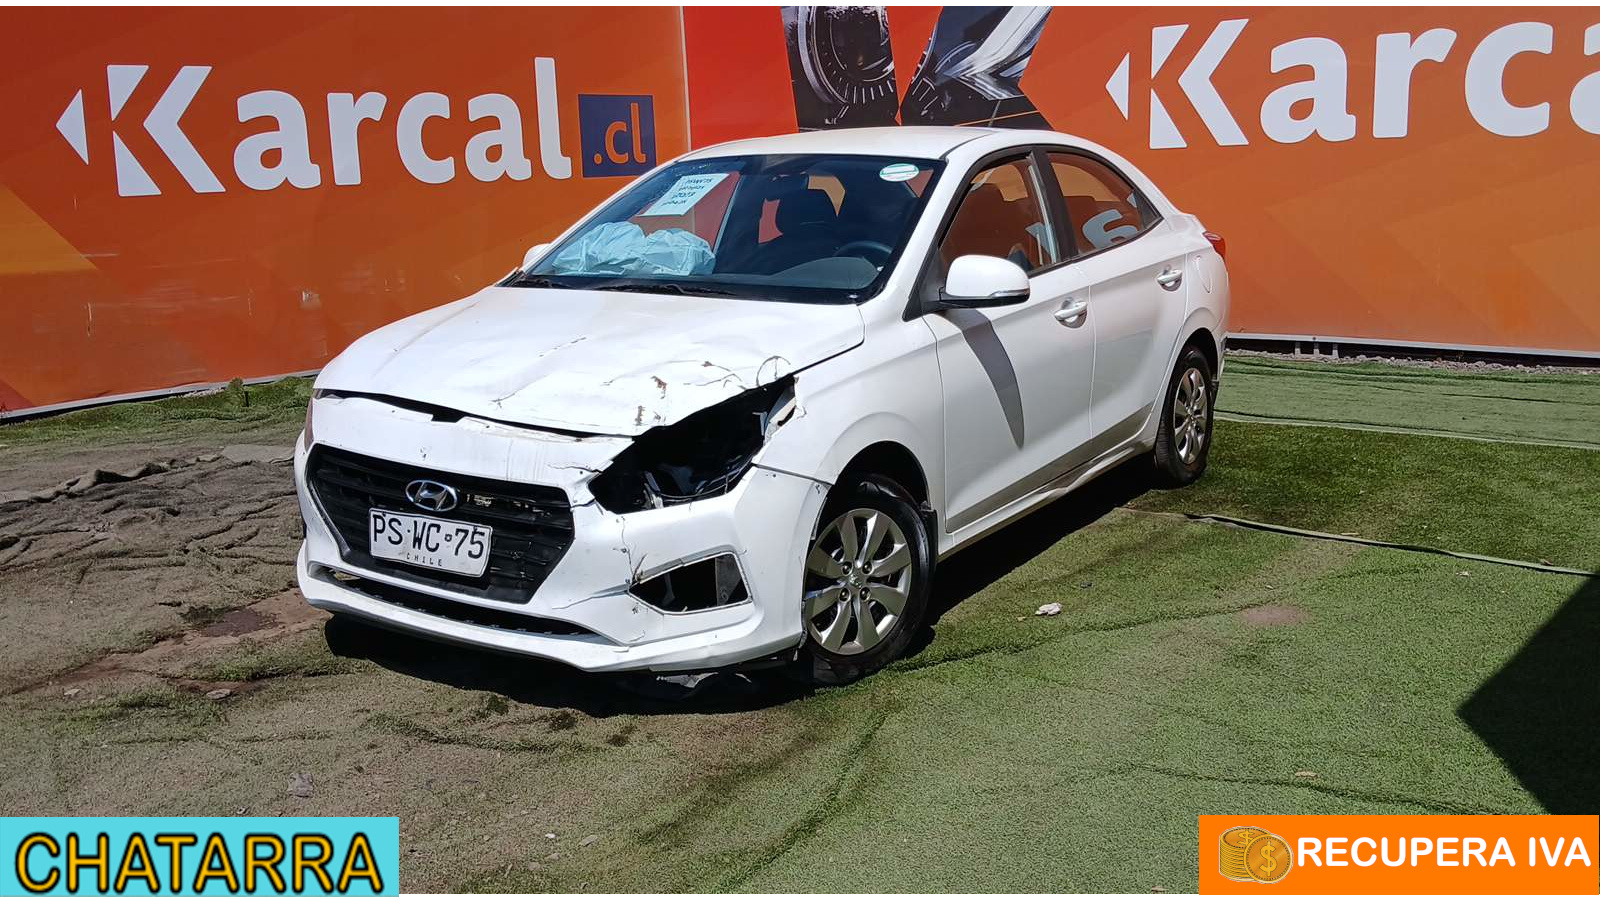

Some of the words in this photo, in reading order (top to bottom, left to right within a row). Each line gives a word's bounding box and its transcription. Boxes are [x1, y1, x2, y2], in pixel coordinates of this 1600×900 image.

[106, 57, 572, 197] Karcal
[593, 102, 646, 164] .cl
[406, 552, 443, 567] CHILE
